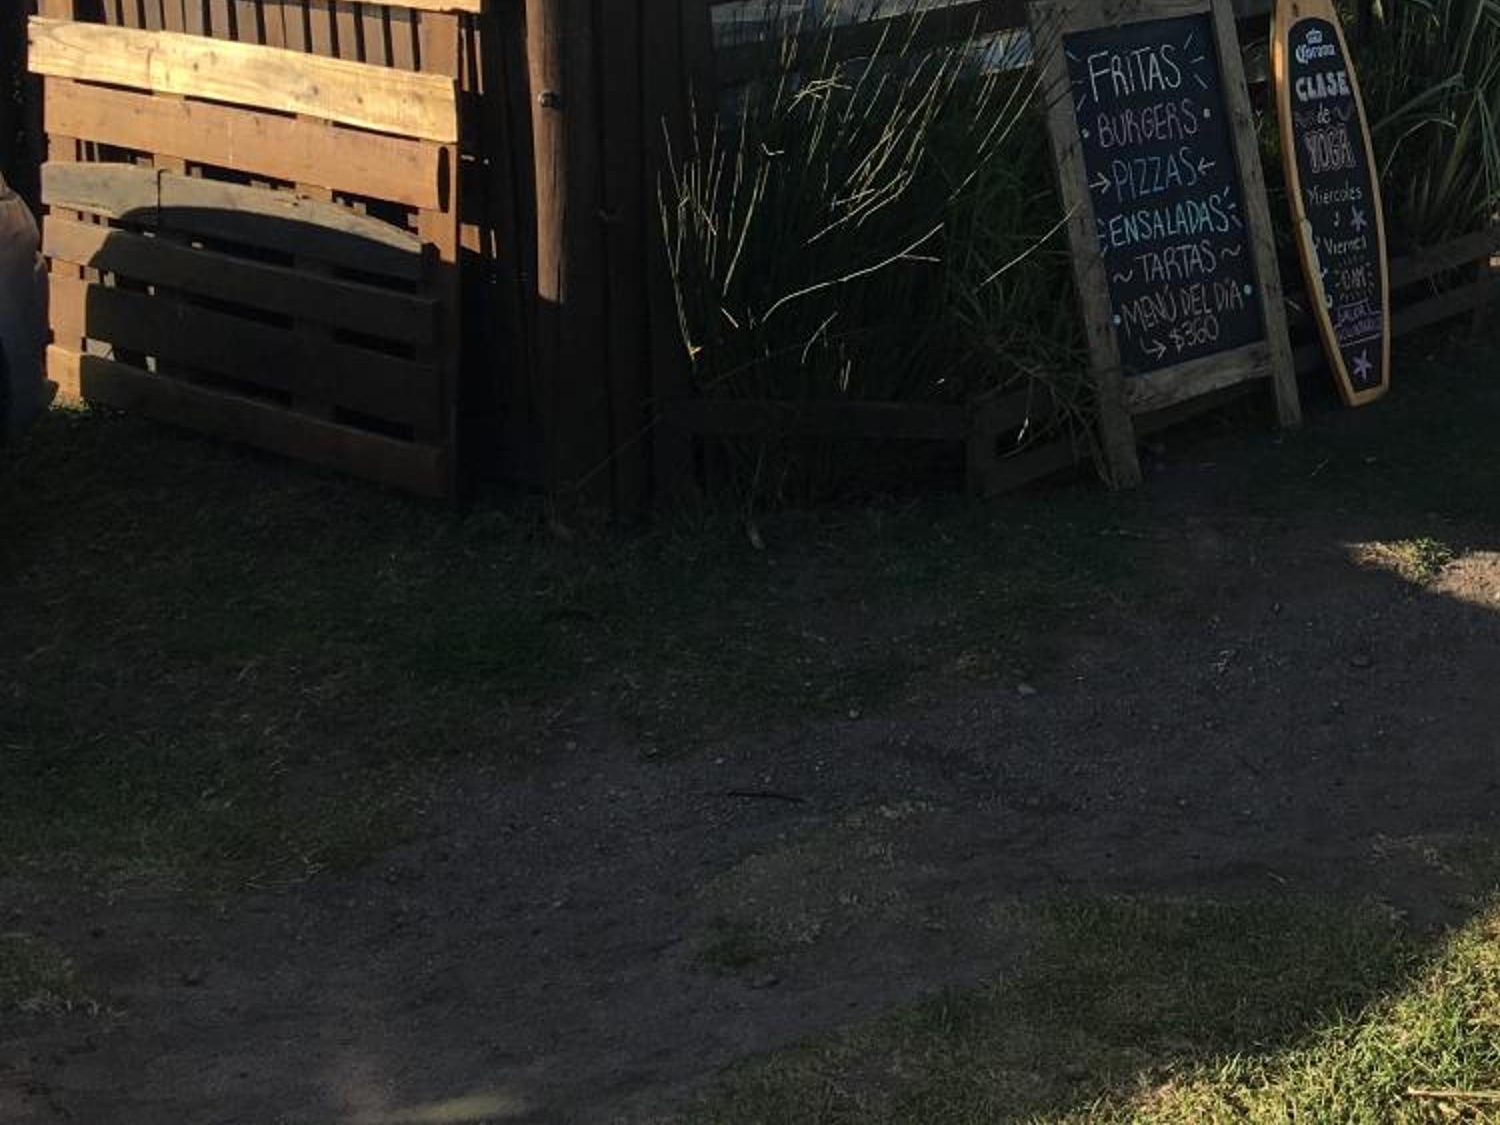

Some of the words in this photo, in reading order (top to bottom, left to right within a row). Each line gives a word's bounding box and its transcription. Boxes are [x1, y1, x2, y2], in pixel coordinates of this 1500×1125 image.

[1087, 44, 1182, 103] FRITAS
[1295, 43, 1336, 65] Corona
[1295, 70, 1350, 102] CLASE
[1096, 98, 1198, 148] BURGERS
[1305, 124, 1357, 174] YOGA
[1111, 146, 1198, 203] PIZZAS
[1109, 194, 1230, 247] ENSALADAS
[1135, 239, 1217, 283] TARTAS
[1180, 282, 1212, 317] DEL
